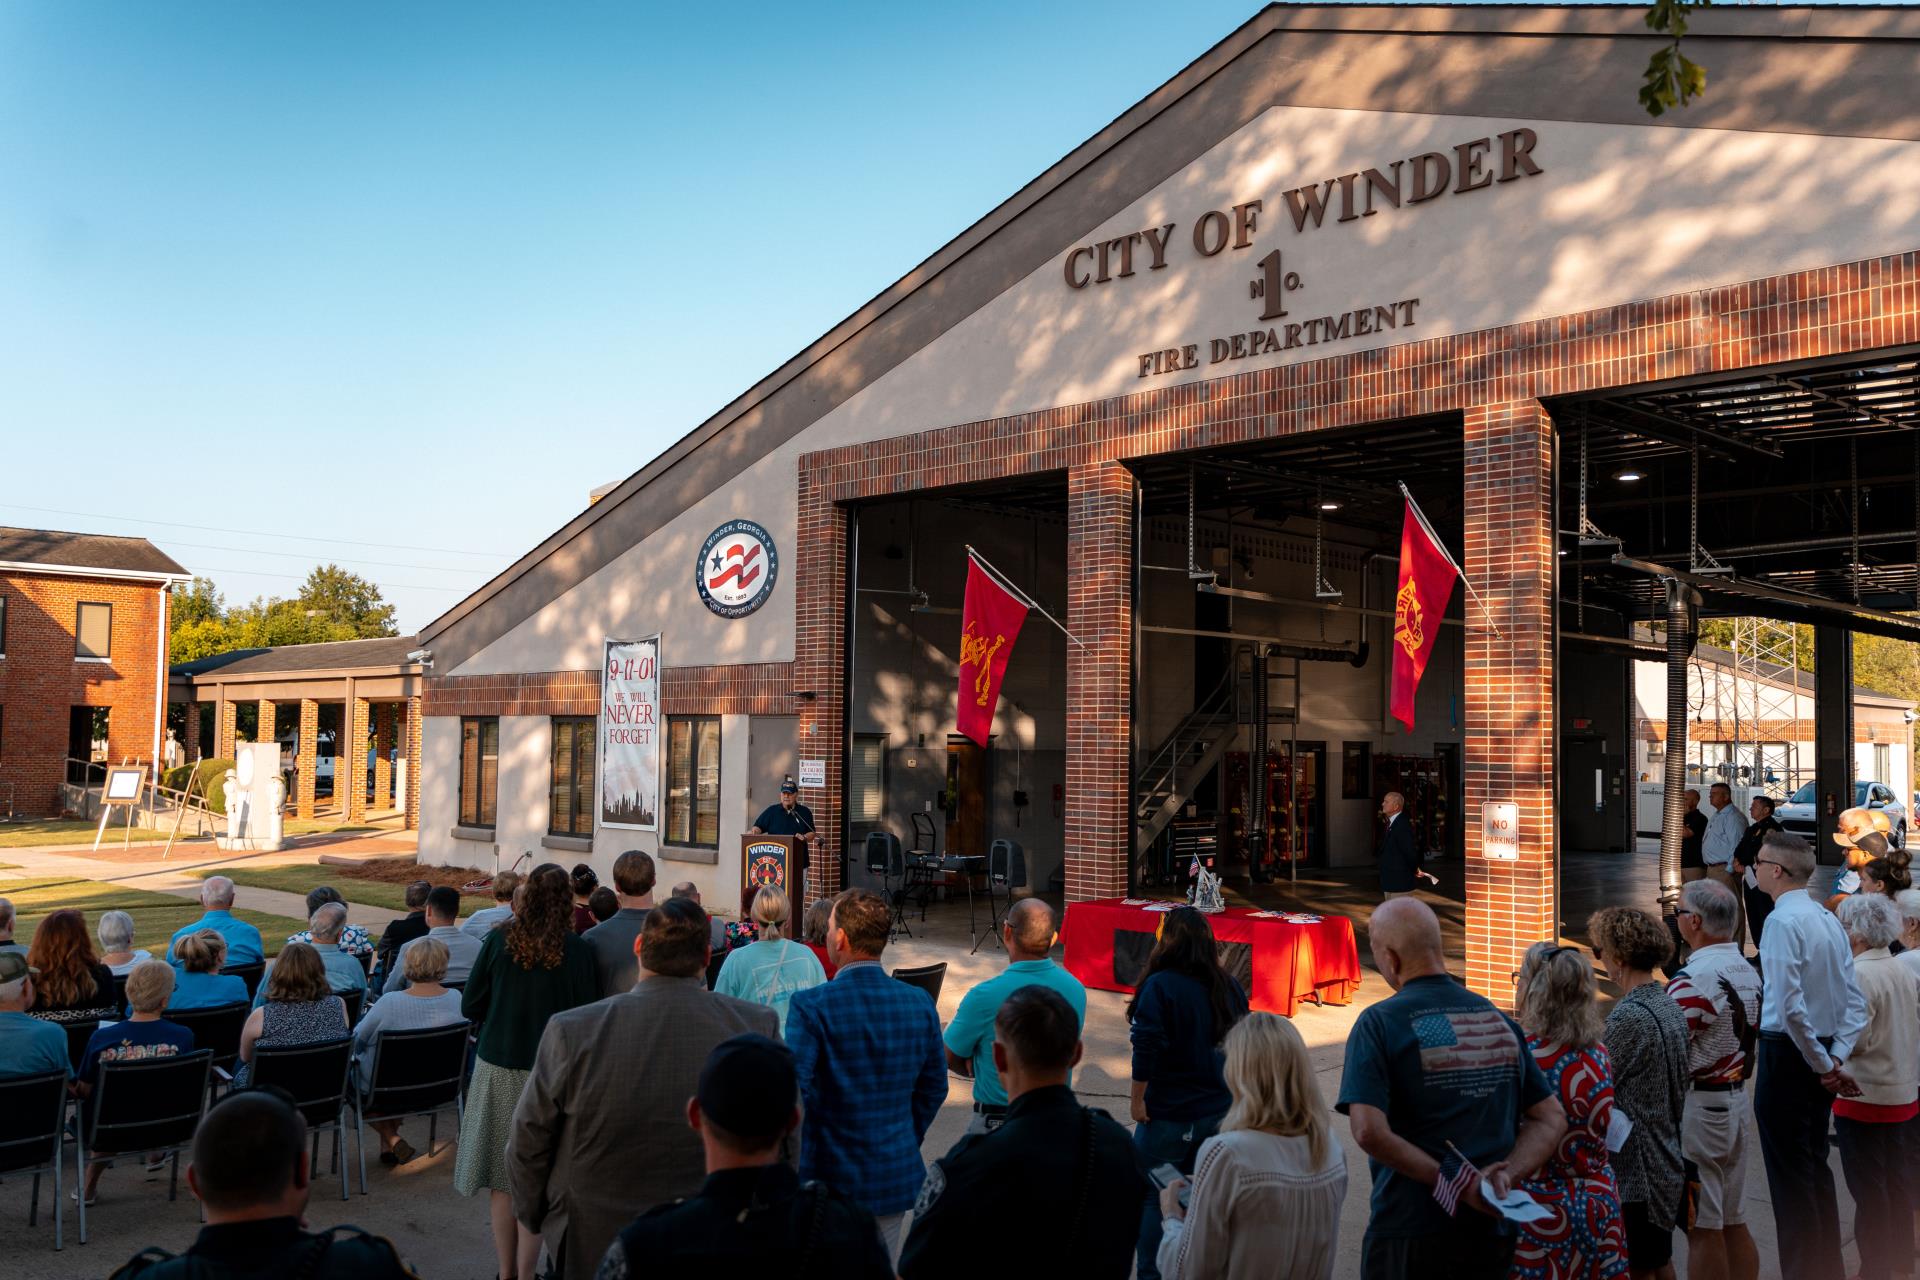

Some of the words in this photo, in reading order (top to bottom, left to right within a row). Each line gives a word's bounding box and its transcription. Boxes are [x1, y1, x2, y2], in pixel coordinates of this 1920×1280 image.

[1064, 222, 1176, 290] CITY
[1193, 199, 1263, 257] OF
[1282, 127, 1545, 233] WINDER
[1138, 344, 1199, 378] FIRE
[1209, 298, 1420, 364] DEPARTMENT
[706, 525, 735, 547] WINDER,
[737, 522, 766, 541] GEORGIA
[721, 606, 728, 614] OF
[609, 656, 655, 681] 9-11-01
[615, 692, 625, 703] WE
[630, 691, 647, 703] WILL
[607, 704, 655, 725] NEVER
[609, 728, 651, 745] FORGET
[1492, 819, 1508, 830] NO
[1486, 835, 1515, 845] PARKING
[750, 845, 785, 855] WINDER
